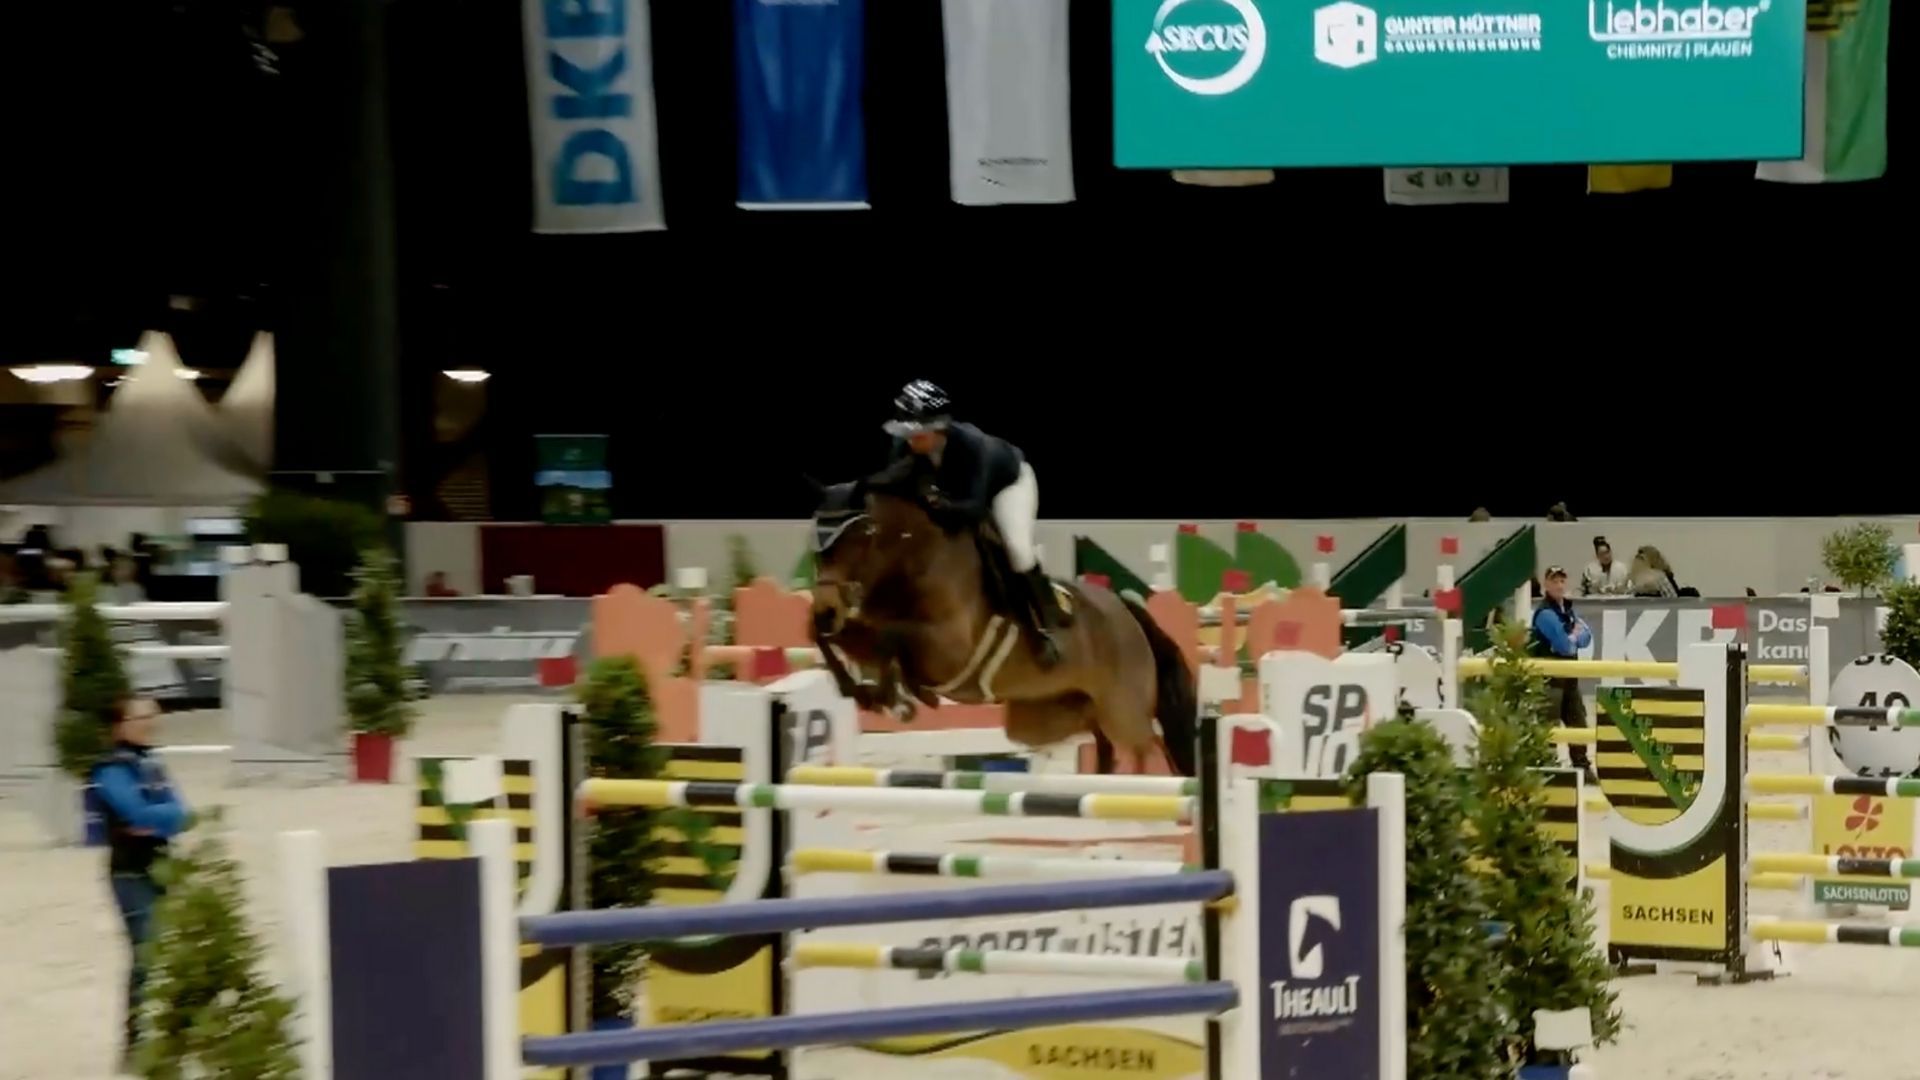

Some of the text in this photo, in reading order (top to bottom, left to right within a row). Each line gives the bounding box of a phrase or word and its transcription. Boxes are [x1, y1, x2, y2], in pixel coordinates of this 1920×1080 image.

[1607, 41, 1753, 59] CHEMNITZ PLAUEN
[1758, 609, 1807, 632] Das
[1823, 886, 1909, 901] SACHSENLOTTO
[1622, 905, 1714, 925] SACHSEN
[1269, 975, 1360, 1020] THEAULT
[1027, 1044, 1156, 1070] SACHSEN
